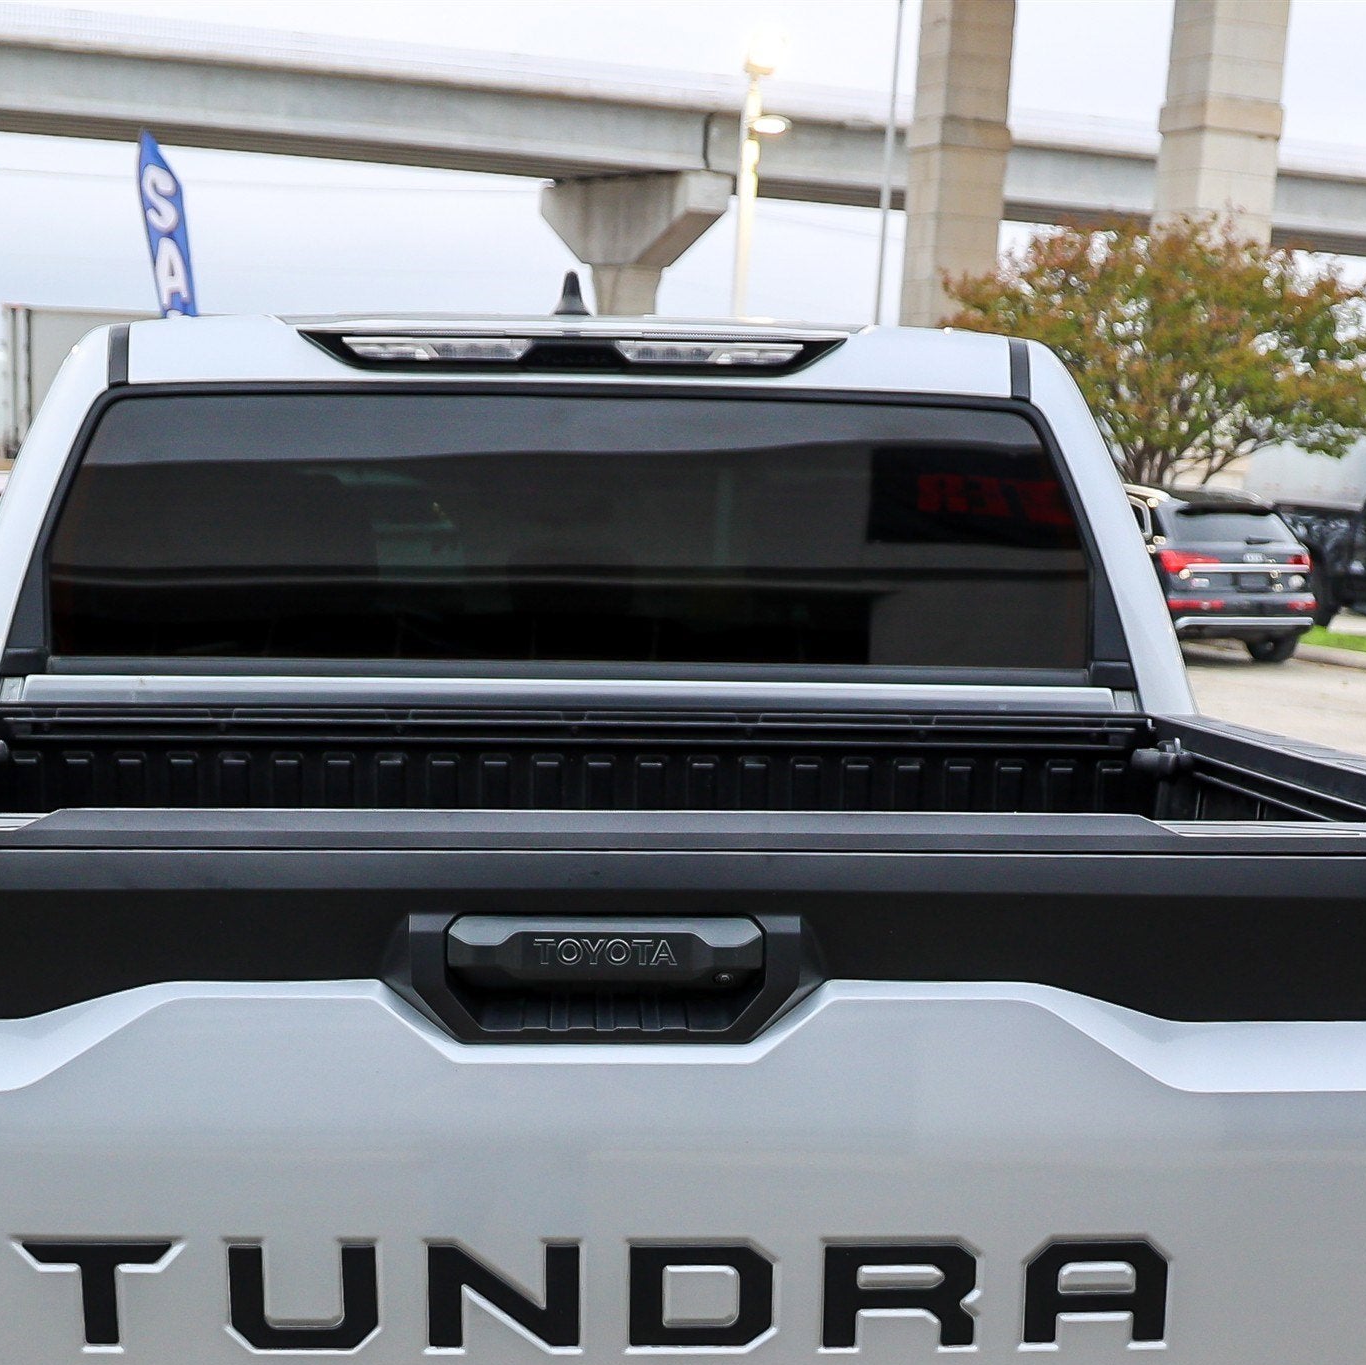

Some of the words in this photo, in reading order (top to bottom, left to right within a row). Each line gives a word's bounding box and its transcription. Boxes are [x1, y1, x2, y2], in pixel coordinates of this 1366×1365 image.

[142, 163, 191, 318] SA
[534, 938, 678, 966] TOYOTA
[12, 1237, 1170, 1353] TUNDRA
